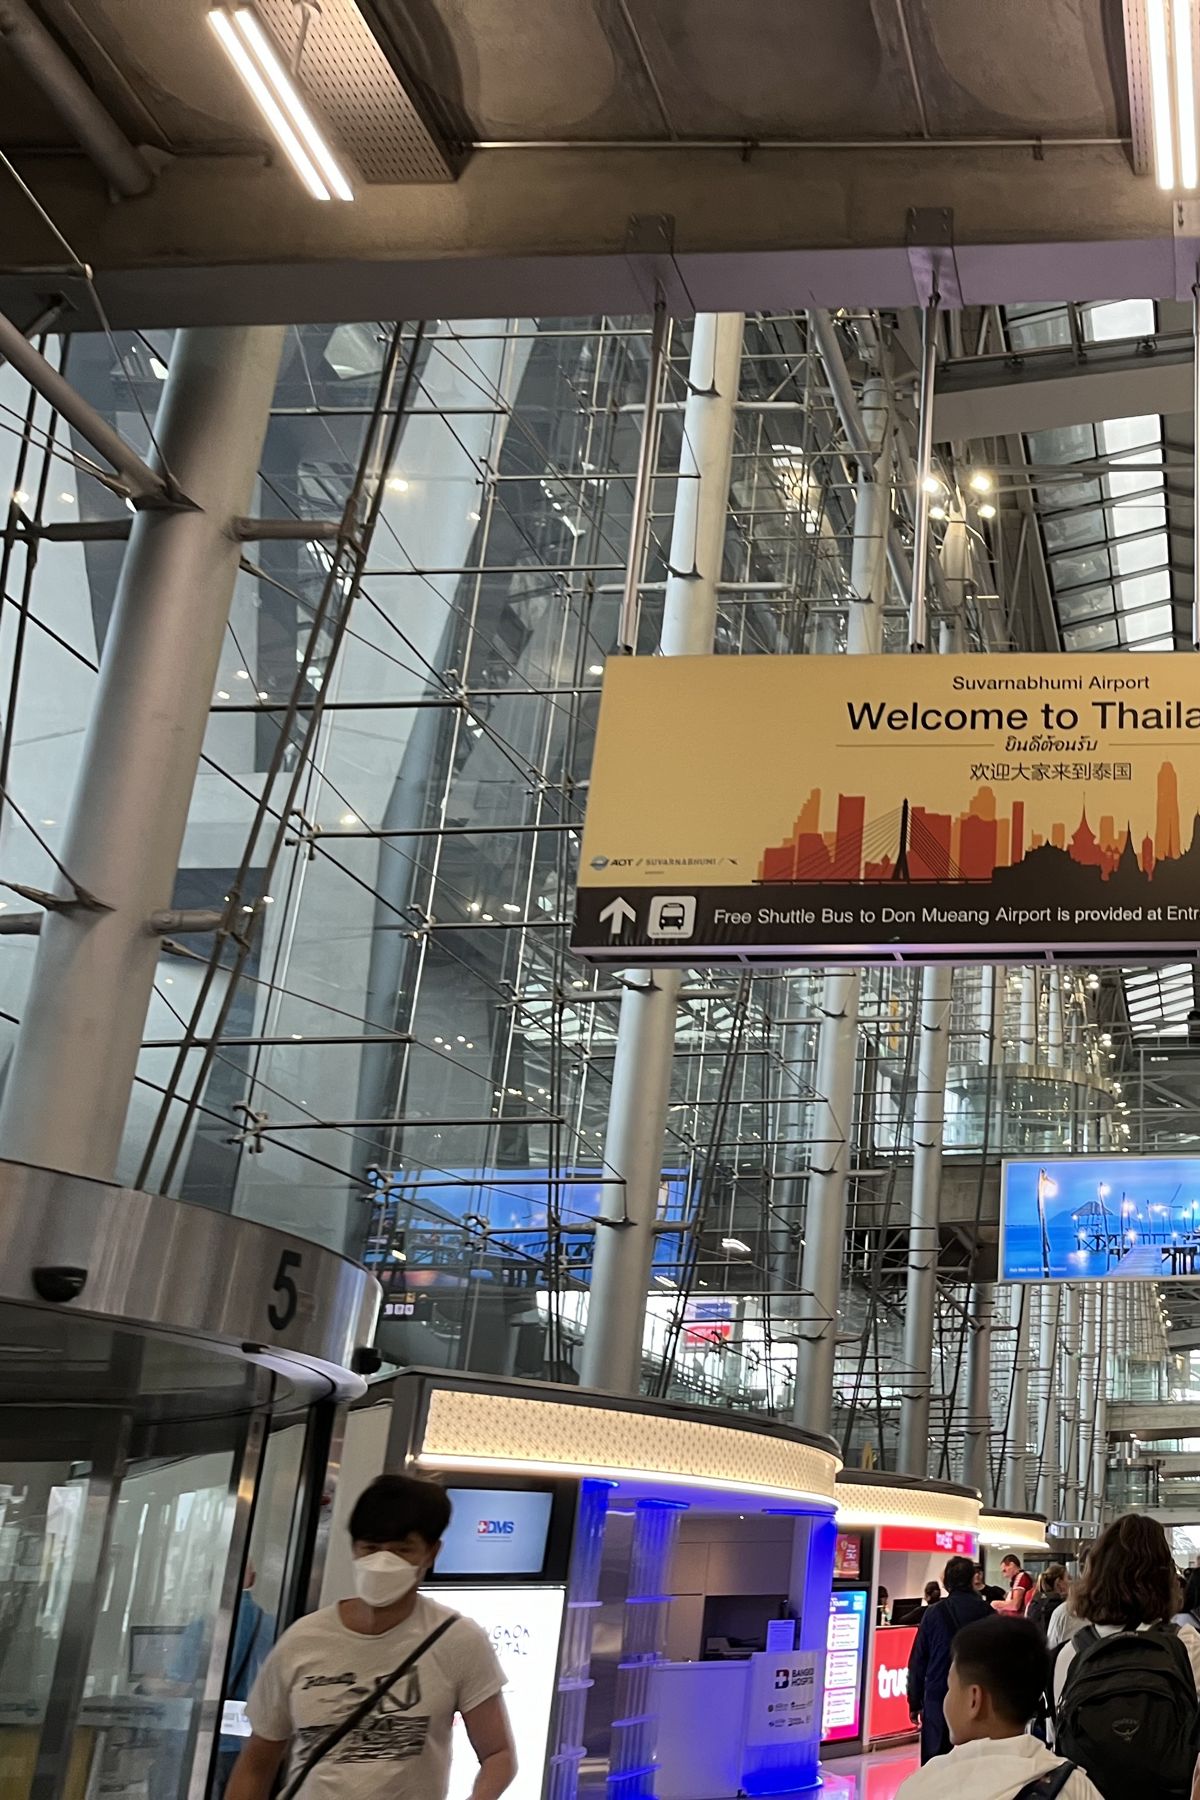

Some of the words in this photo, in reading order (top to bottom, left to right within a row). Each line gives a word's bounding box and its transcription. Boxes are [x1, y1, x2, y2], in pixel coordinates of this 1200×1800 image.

[952, 675, 1083, 690] Suvarnabhumi
[1088, 675, 1150, 692] Airport
[847, 701, 1028, 731] Welcome
[1041, 703, 1079, 731] to
[1004, 734, 1098, 752] ยินดีต้อนรับ
[969, 762, 1132, 781] 欢迎大家来到泰国
[714, 909, 752, 924] Free
[757, 908, 816, 924] Shuttle
[821, 908, 854, 923] Bus
[860, 908, 876, 923] to
[881, 907, 916, 923] Don
[922, 907, 990, 925] Mueang
[995, 906, 1051, 924] Airport
[1057, 906, 1070, 921] is
[1075, 906, 1142, 923] provided
[1147, 906, 1162, 921] at
[267, 1249, 302, 1330] 5
